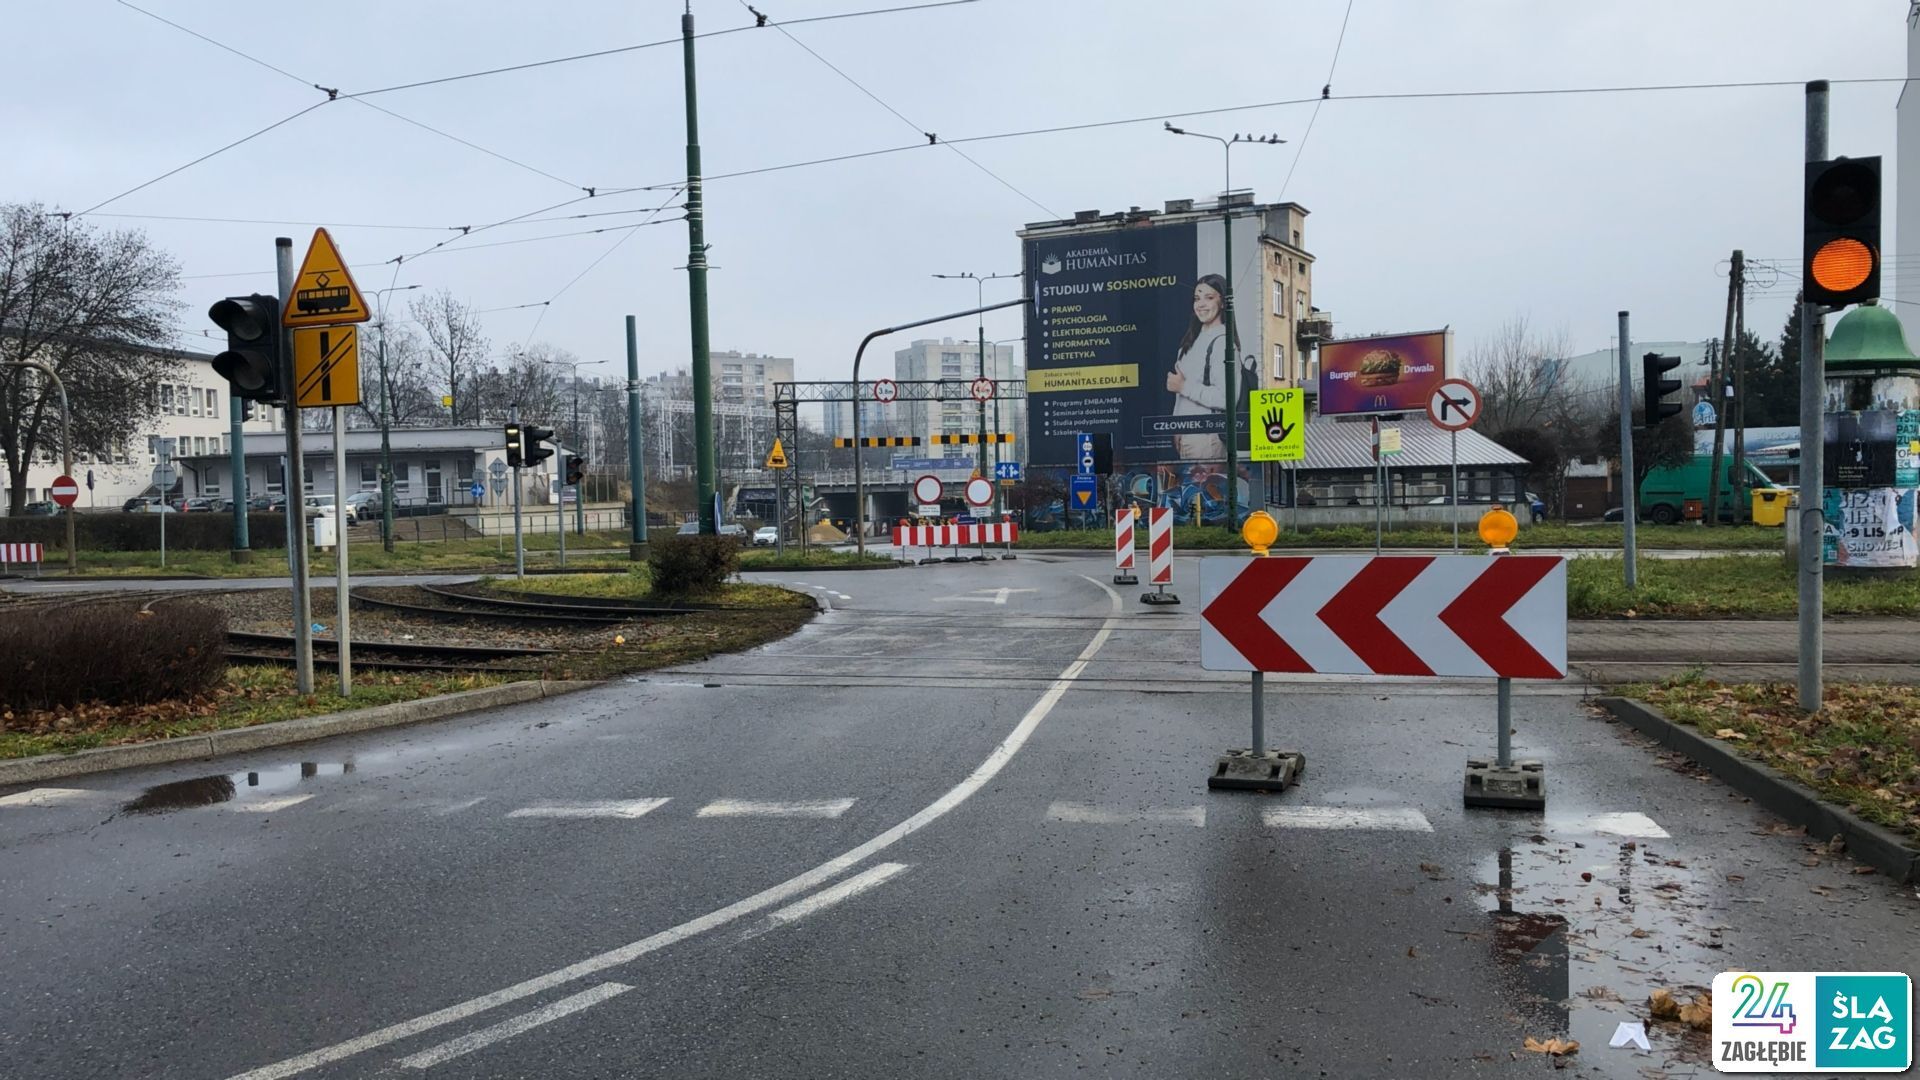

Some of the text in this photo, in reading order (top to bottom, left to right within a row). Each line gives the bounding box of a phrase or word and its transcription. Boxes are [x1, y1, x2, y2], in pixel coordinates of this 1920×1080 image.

[1066, 247, 1109, 258] AKADEMIA
[1066, 252, 1147, 271] HUMANITAS
[1043, 275, 1177, 297] STUDIUJ W SOSNOWCU
[1051, 305, 1082, 314] PRAWO
[1052, 315, 1108, 326] PSYCHOLOGIA
[1052, 324, 1137, 338] ELEKTRORADIOLOGIA
[1052, 338, 1111, 349] INFORMATYKA
[1052, 351, 1096, 360] DIETETYKA
[1329, 363, 1435, 381] Burger Drwala
[1044, 375, 1131, 388] HUMANITAS.EDU.PL
[1052, 397, 1123, 408] Programy EMBA/MBA
[1261, 391, 1294, 405] STOP
[1052, 407, 1120, 417] Seminaria doktorskie
[1053, 418, 1119, 427] Studia podyplomowe
[1153, 420, 1203, 431] CZŁOWIEK.
[1205, 420, 1214, 428] To
